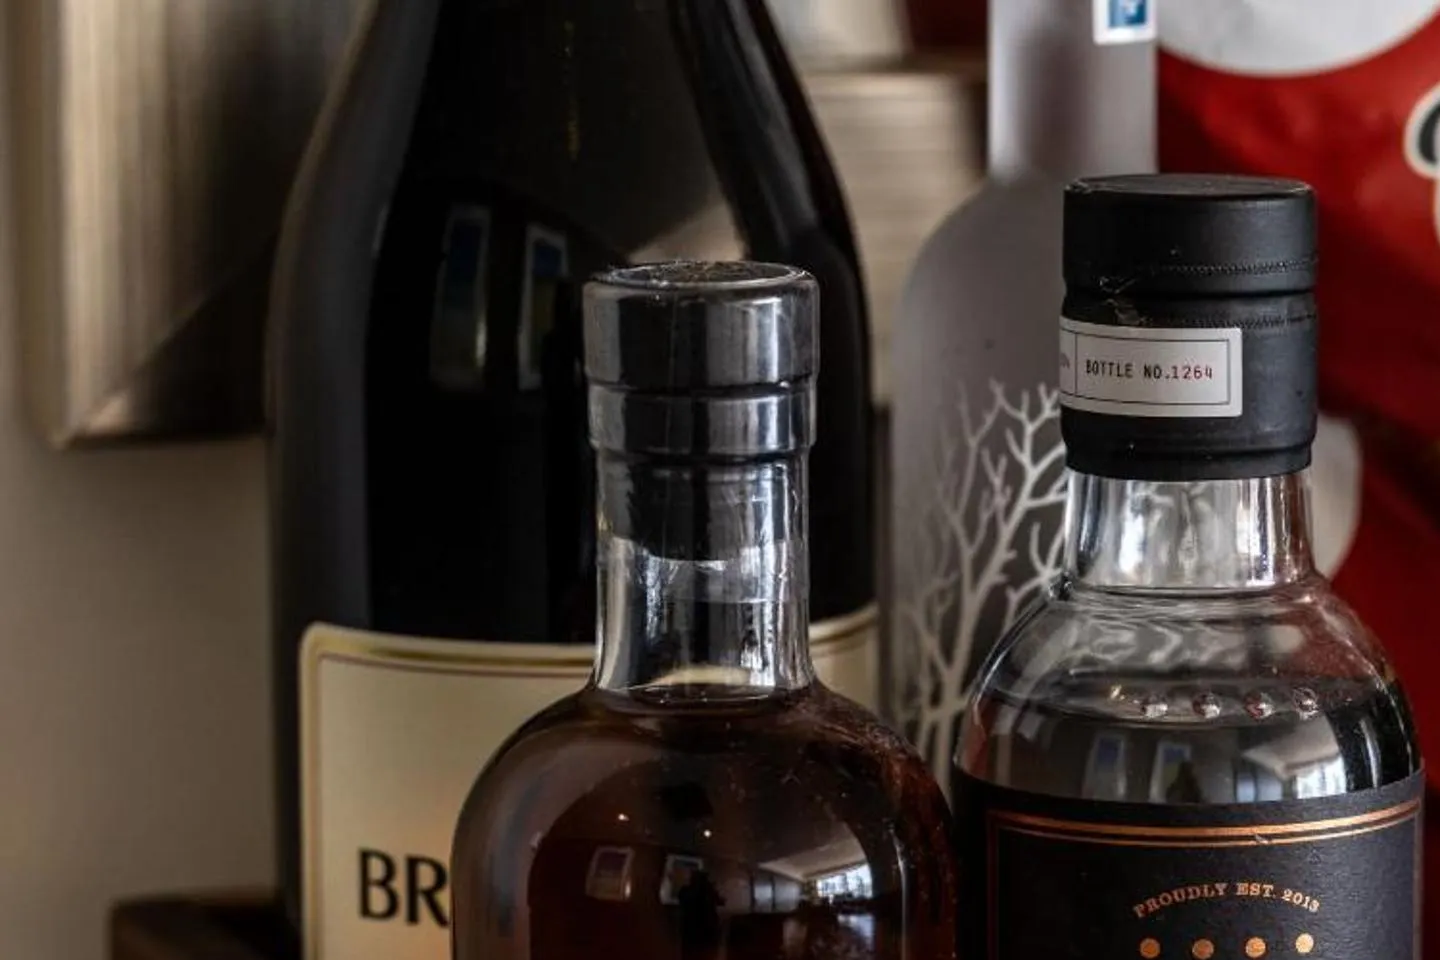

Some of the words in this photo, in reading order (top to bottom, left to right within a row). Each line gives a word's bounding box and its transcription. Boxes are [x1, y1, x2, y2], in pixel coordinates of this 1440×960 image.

[1085, 358, 1134, 379] BOTTLE
[1133, 882, 1228, 919] PROUDLY
[1235, 882, 1276, 898] EST.
[1281, 888, 1320, 913] 2013
